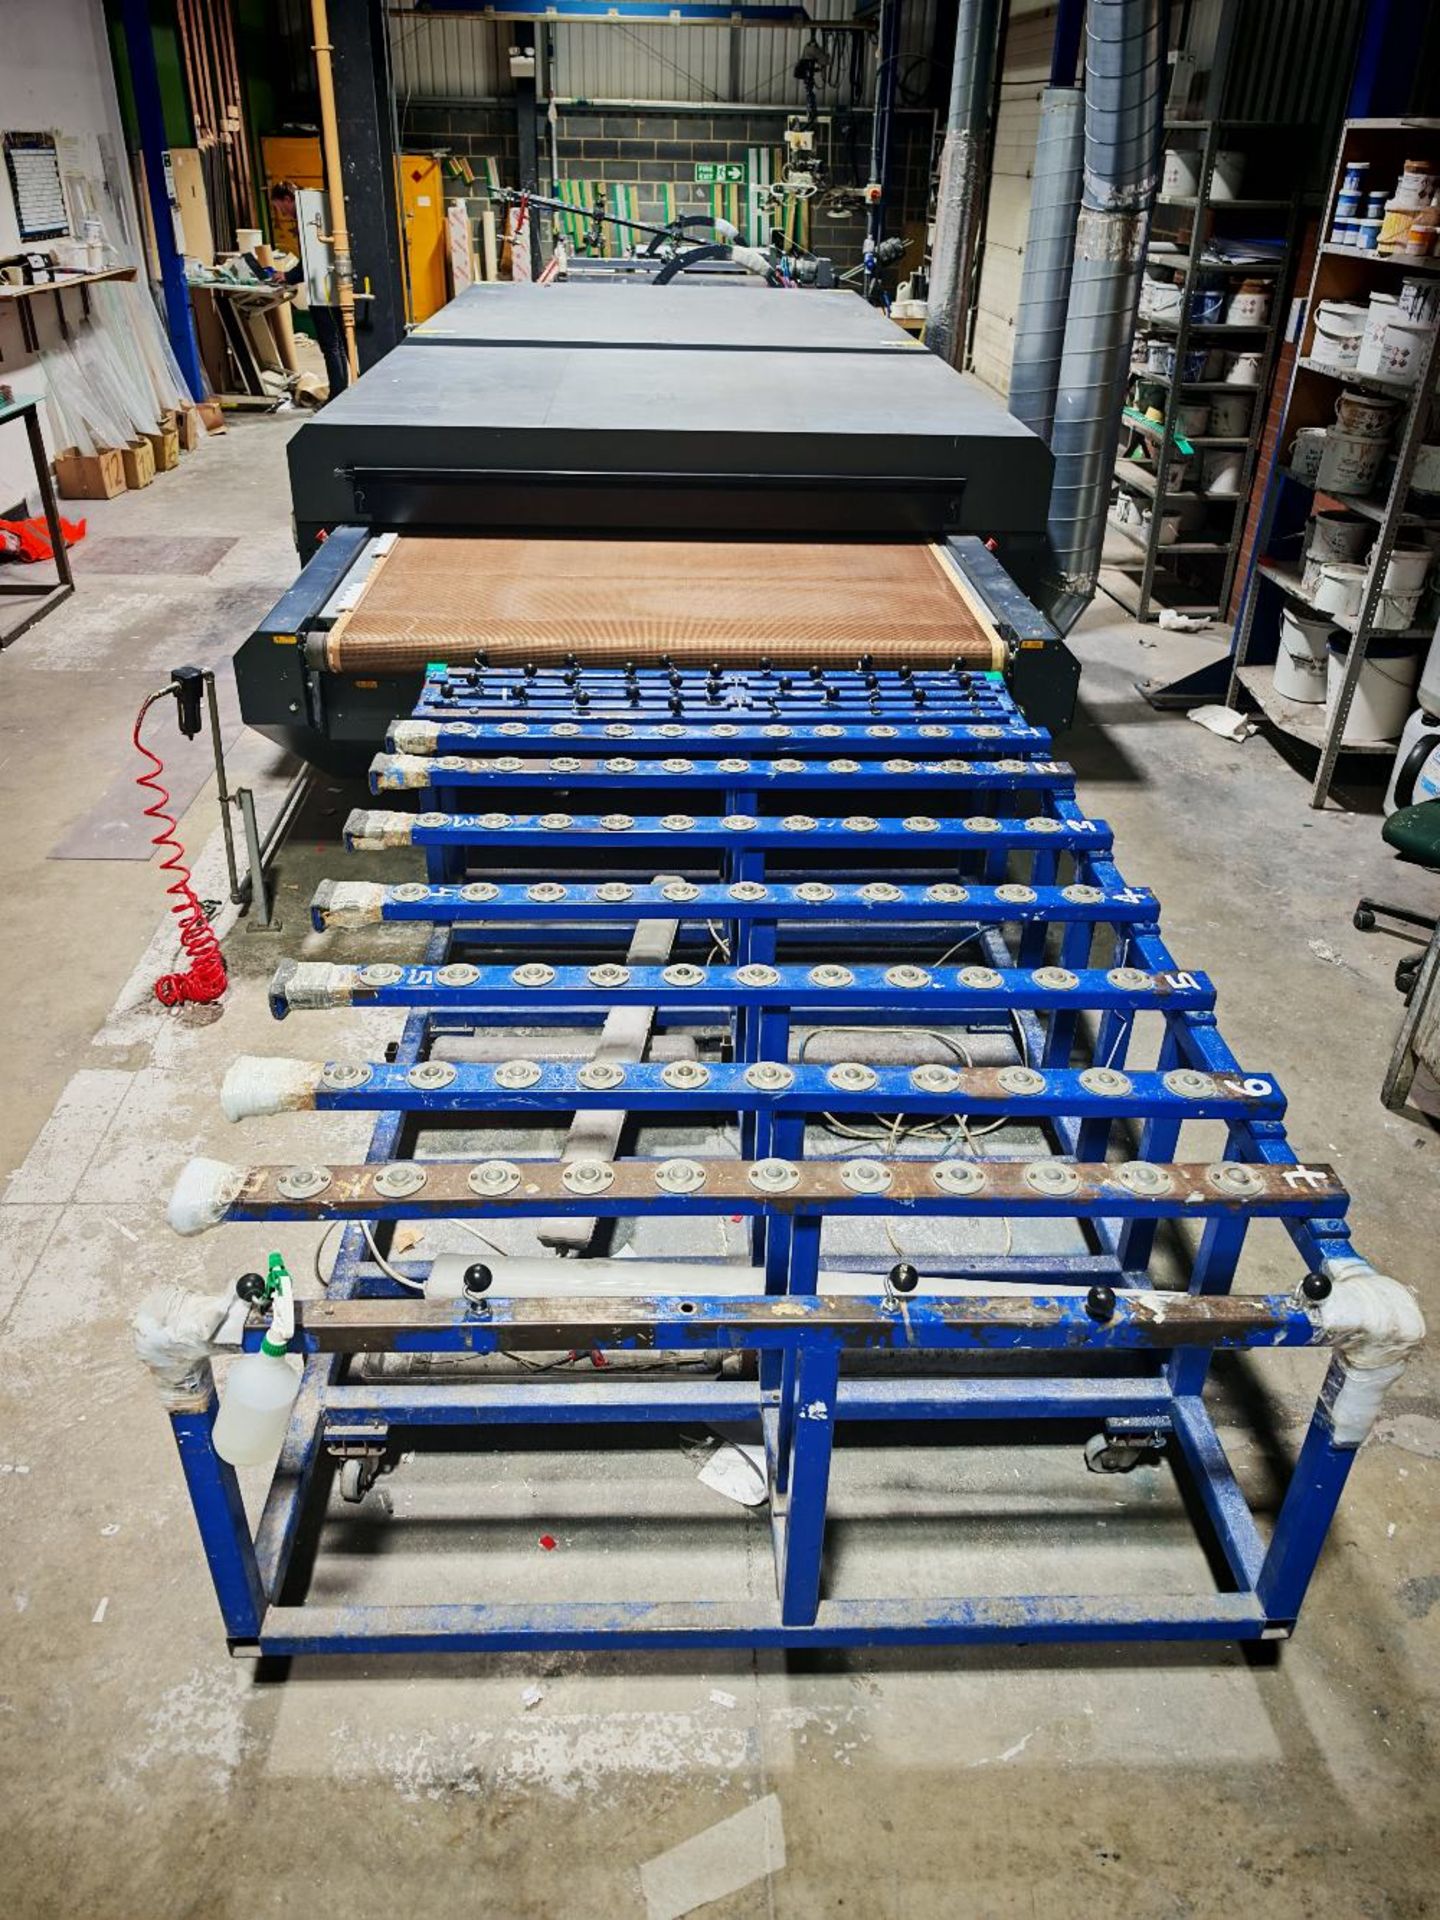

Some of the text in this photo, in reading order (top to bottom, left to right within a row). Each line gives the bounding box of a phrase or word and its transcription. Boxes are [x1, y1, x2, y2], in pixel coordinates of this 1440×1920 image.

[1066, 820, 1096, 832] 3
[430, 886, 458, 897] 4
[1112, 887, 1147, 904] 4
[407, 968, 433, 985] 5
[1165, 971, 1202, 990] 5
[1223, 1078, 1273, 1097] 6
[1281, 1164, 1328, 1189] 7
